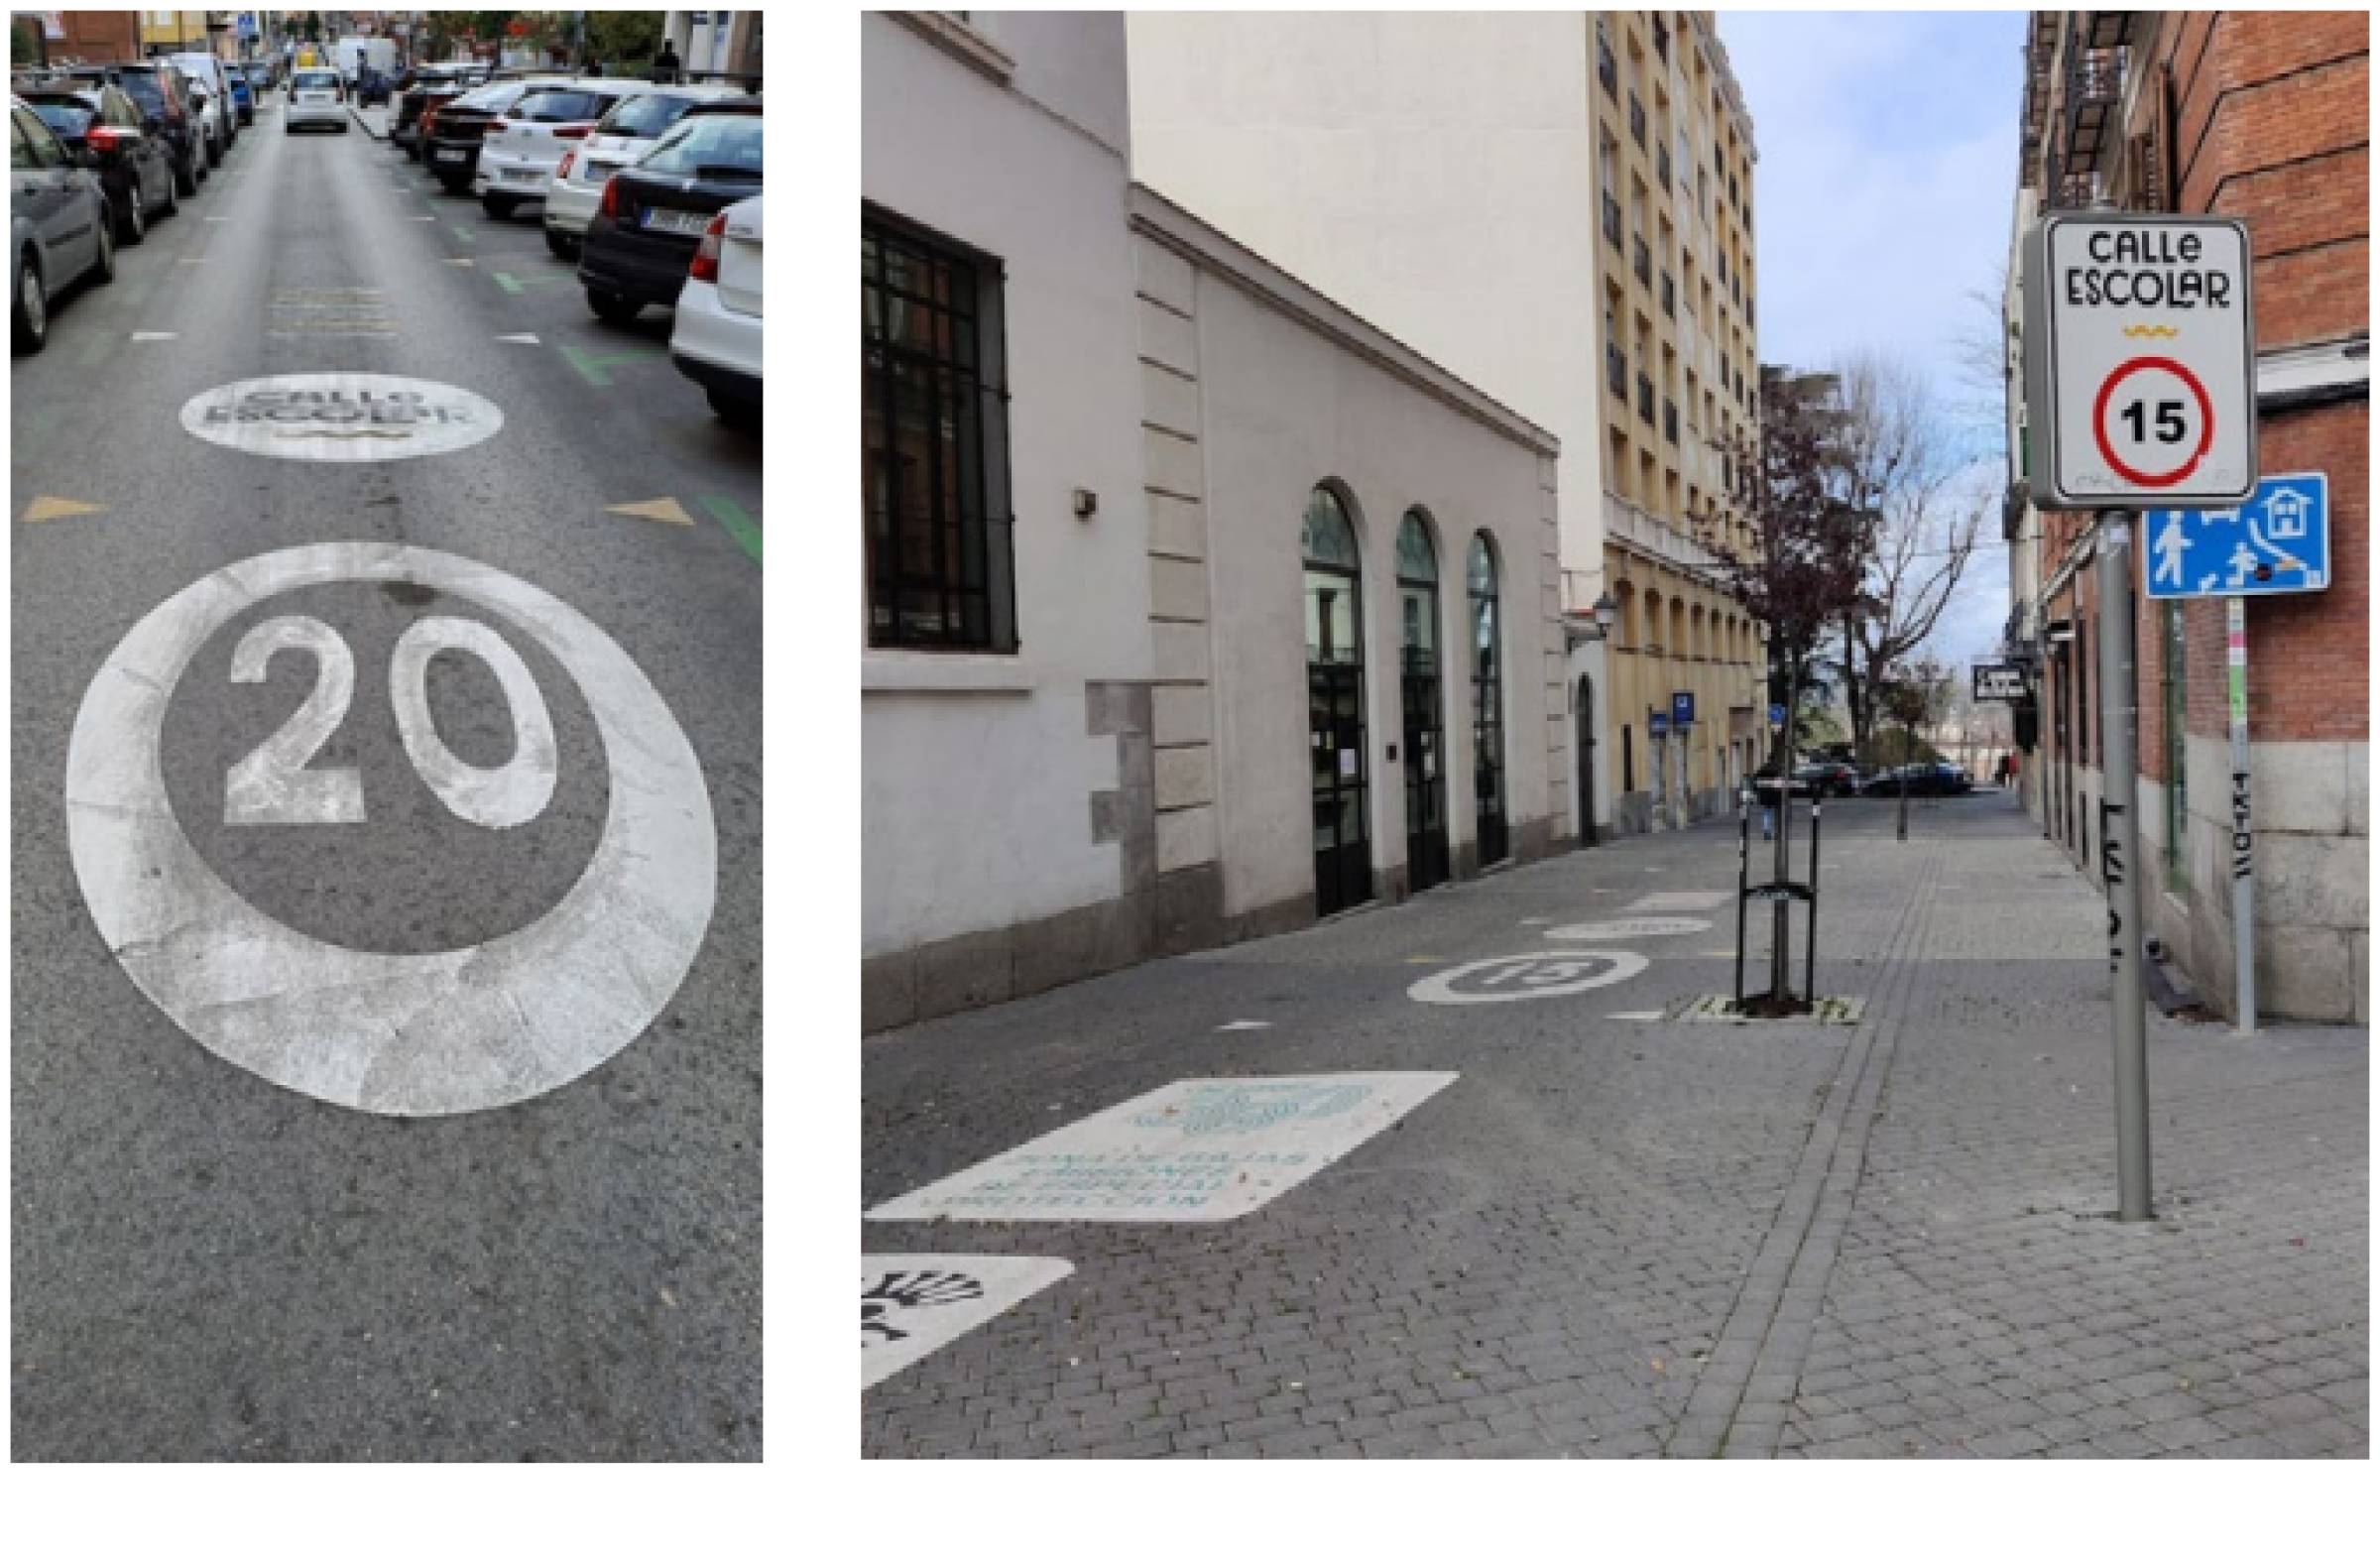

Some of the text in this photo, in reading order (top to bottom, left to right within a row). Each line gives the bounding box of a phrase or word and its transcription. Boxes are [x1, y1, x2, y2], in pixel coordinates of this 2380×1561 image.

[2066, 266, 2230, 308] ESCOLAR
[2120, 398, 2188, 445] 15
[223, 614, 557, 830] 20
